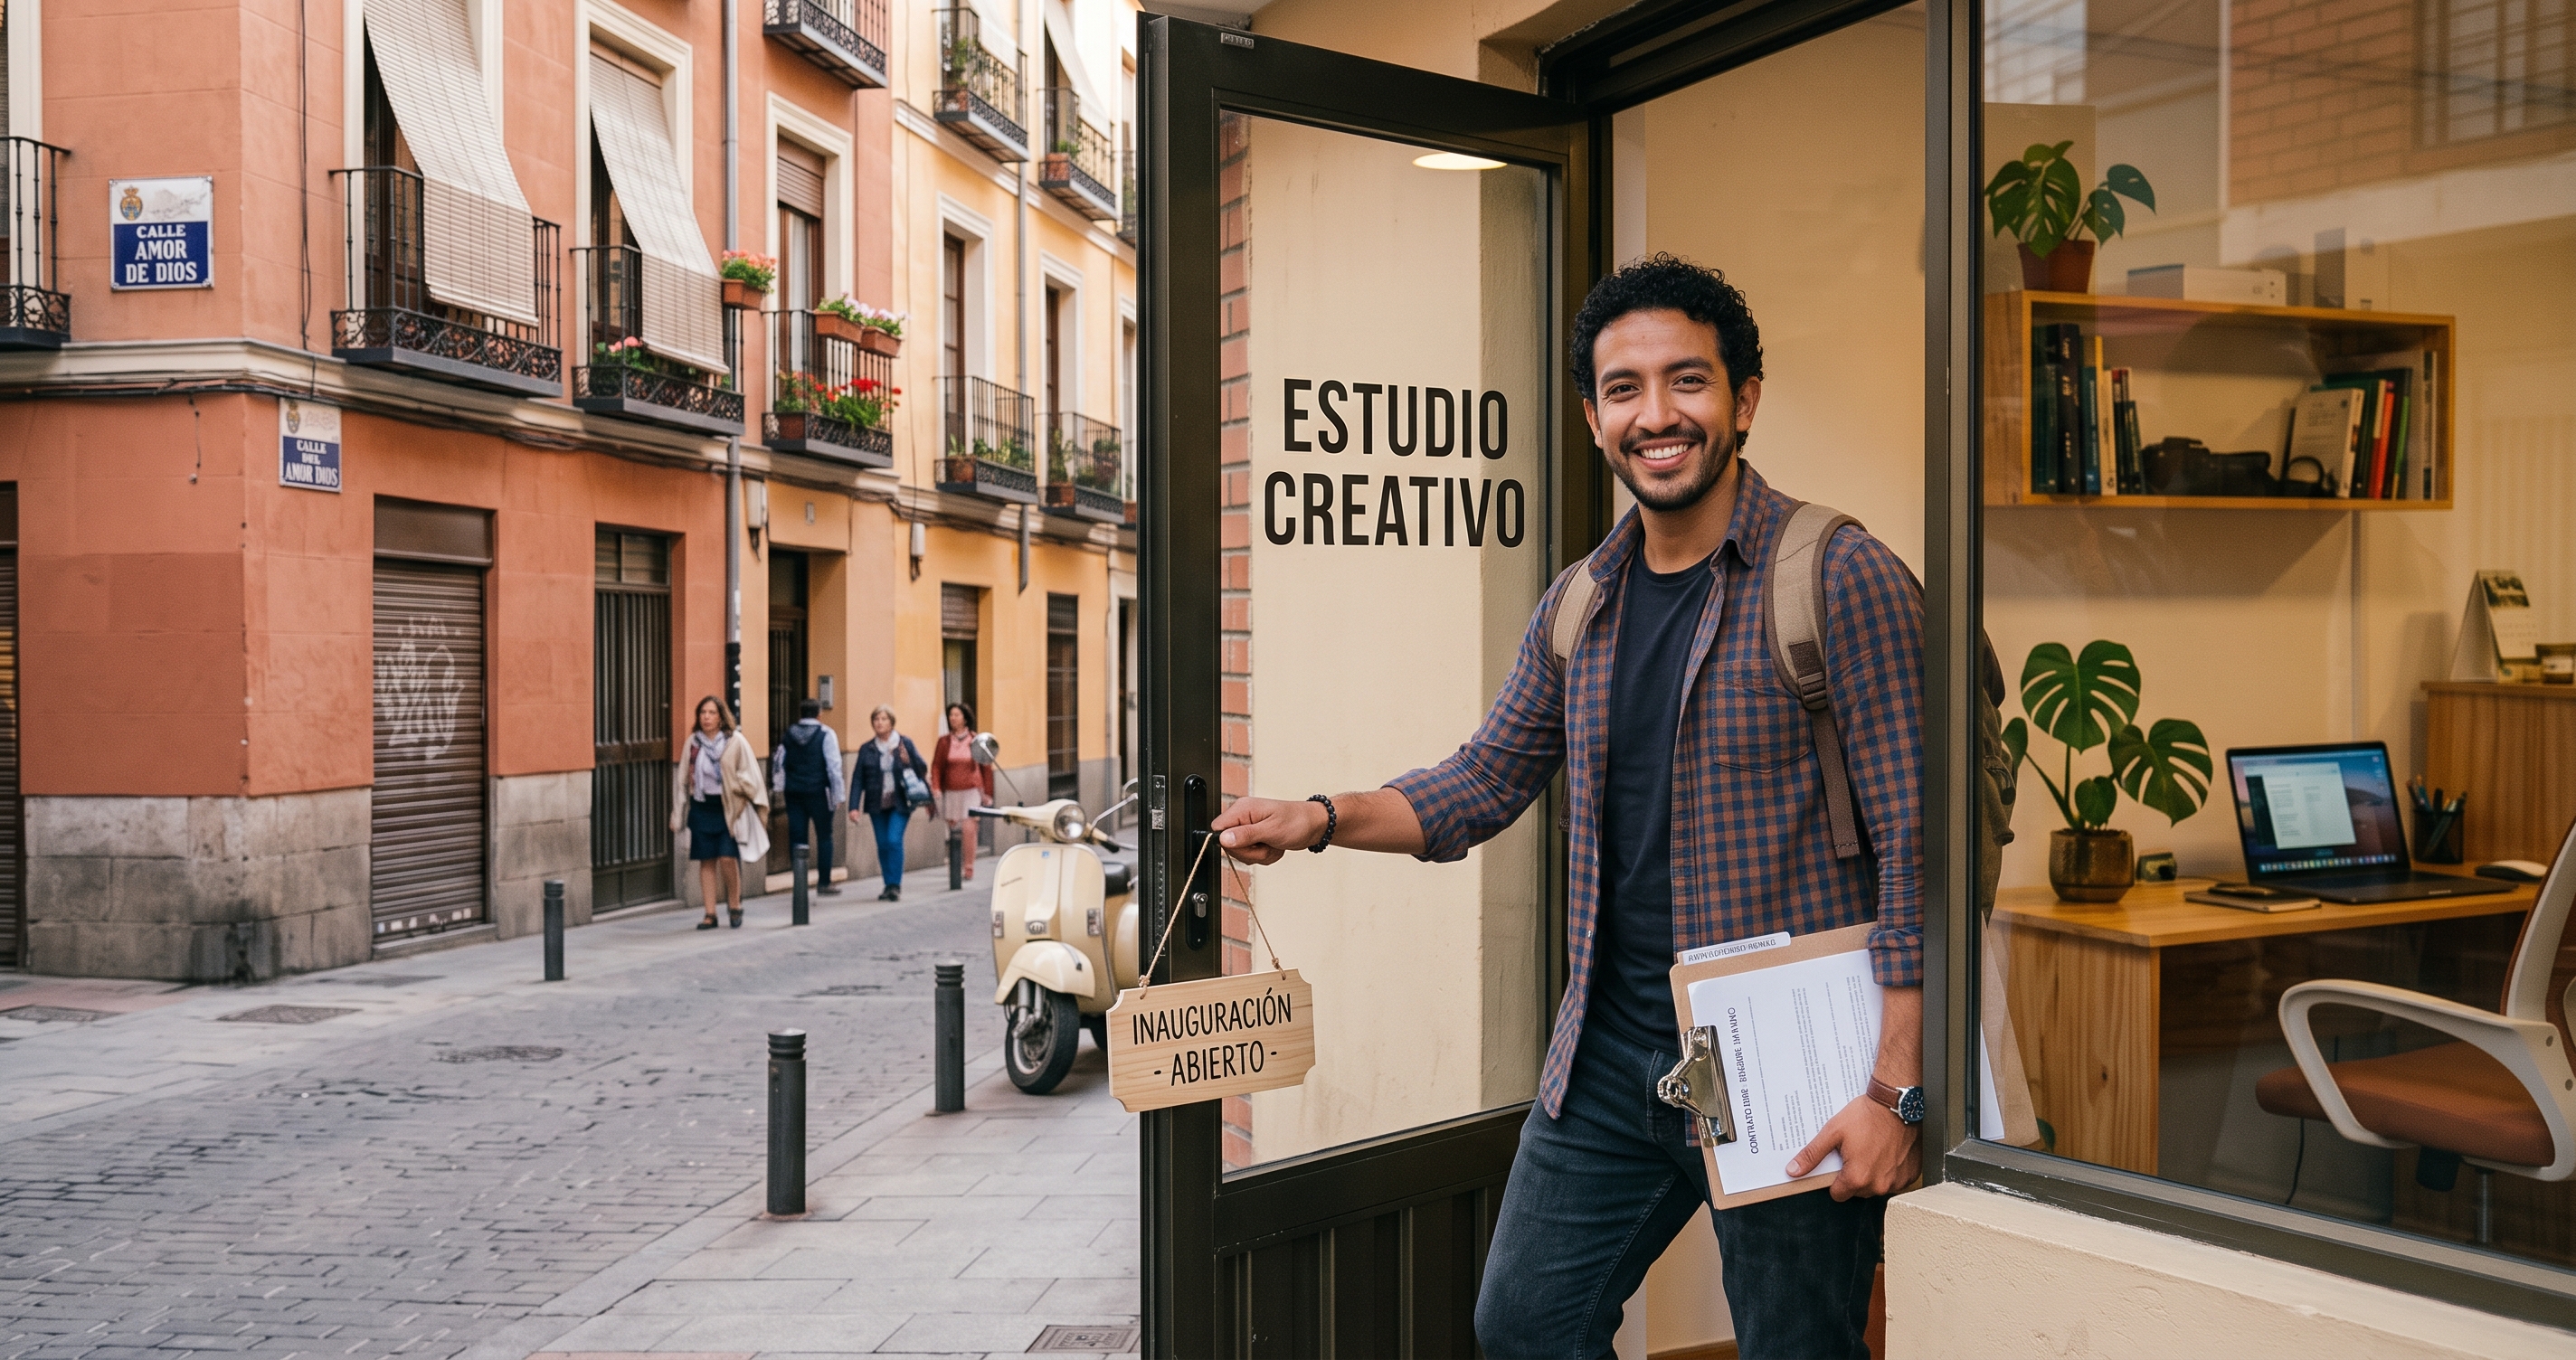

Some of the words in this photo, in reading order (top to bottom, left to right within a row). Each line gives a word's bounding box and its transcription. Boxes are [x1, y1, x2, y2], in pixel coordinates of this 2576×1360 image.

[137, 224, 186, 239] CALLE
[135, 240, 187, 260] AMOR
[125, 263, 149, 283] DE
[156, 261, 197, 282] DIOS
[1283, 378, 1508, 460] ESTUDIO
[297, 439, 327, 454] CALLE
[315, 466, 338, 486] DIOS
[1264, 471, 1525, 548] CREATIVO
[1132, 987, 1292, 1045] INAUGURACIÓN
[1170, 1040, 1264, 1086] ABIERTO
